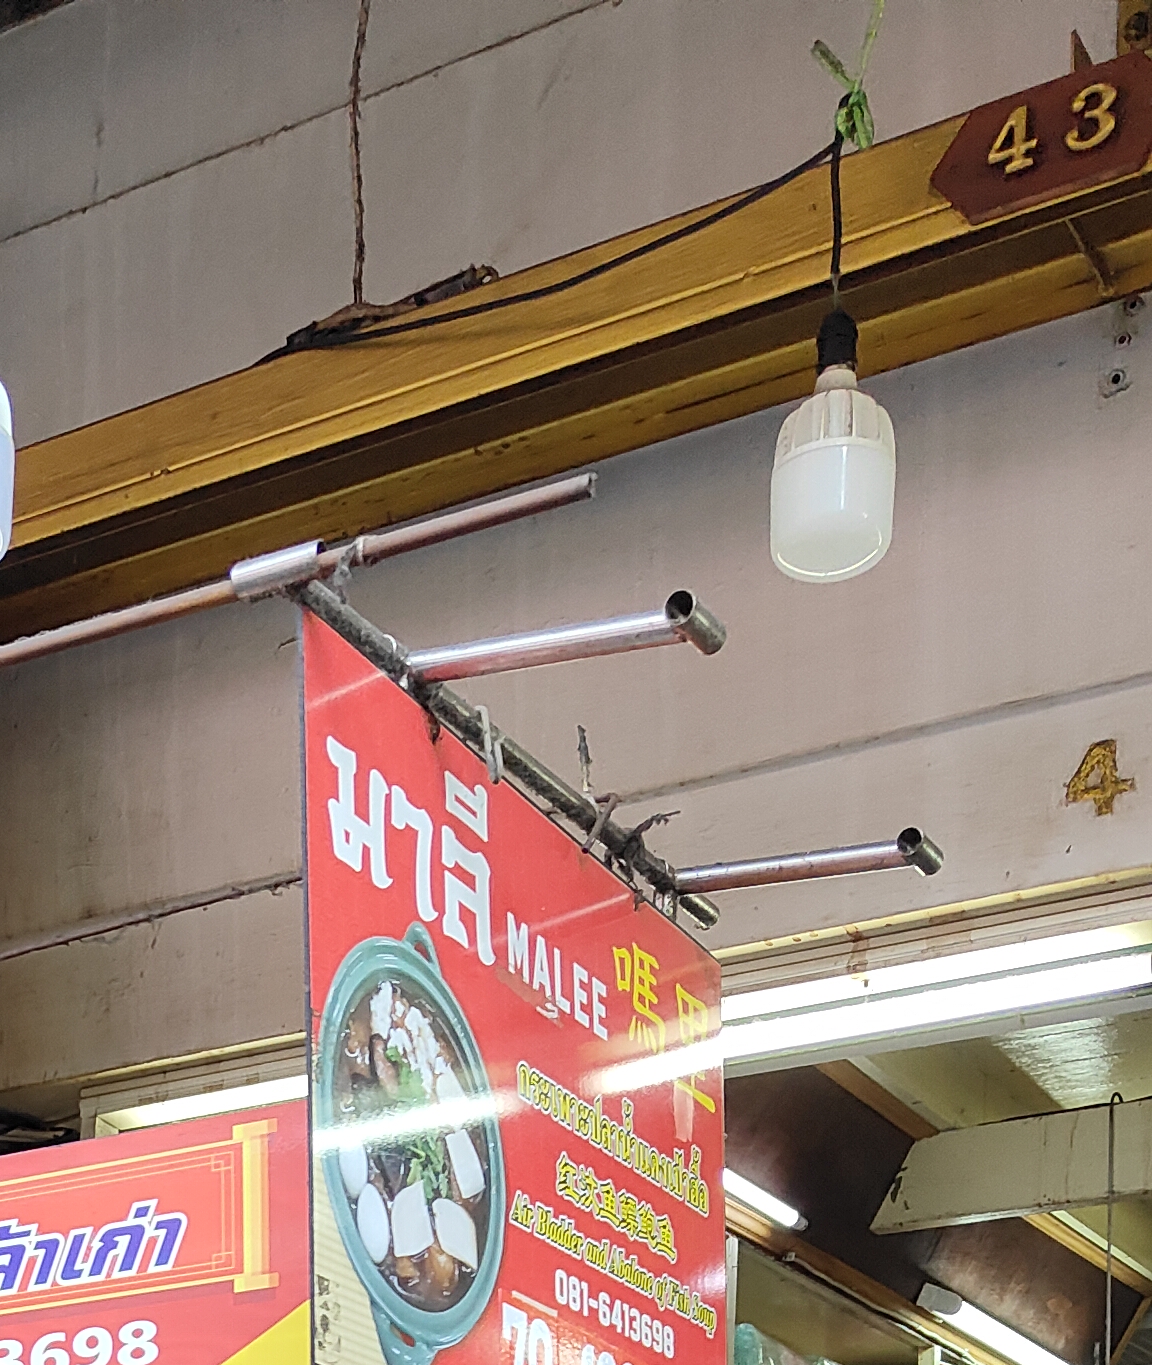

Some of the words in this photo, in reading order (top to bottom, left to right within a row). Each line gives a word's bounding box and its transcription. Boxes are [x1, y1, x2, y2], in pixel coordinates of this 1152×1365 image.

[987, 82, 1118, 175] 43
[325, 735, 496, 966] มาลี
[506, 912, 609, 1041] MALEE
[509, 1190, 535, 1233] Air
[534, 1202, 584, 1260] Bladder
[585, 1239, 610, 1273] and
[608, 1245, 654, 1297] Abalone
[654, 1273, 669, 1311] of
[666, 1279, 692, 1320] Fish
[691, 1293, 718, 1339] Soup
[554, 1268, 675, 1360] 081-6413698
